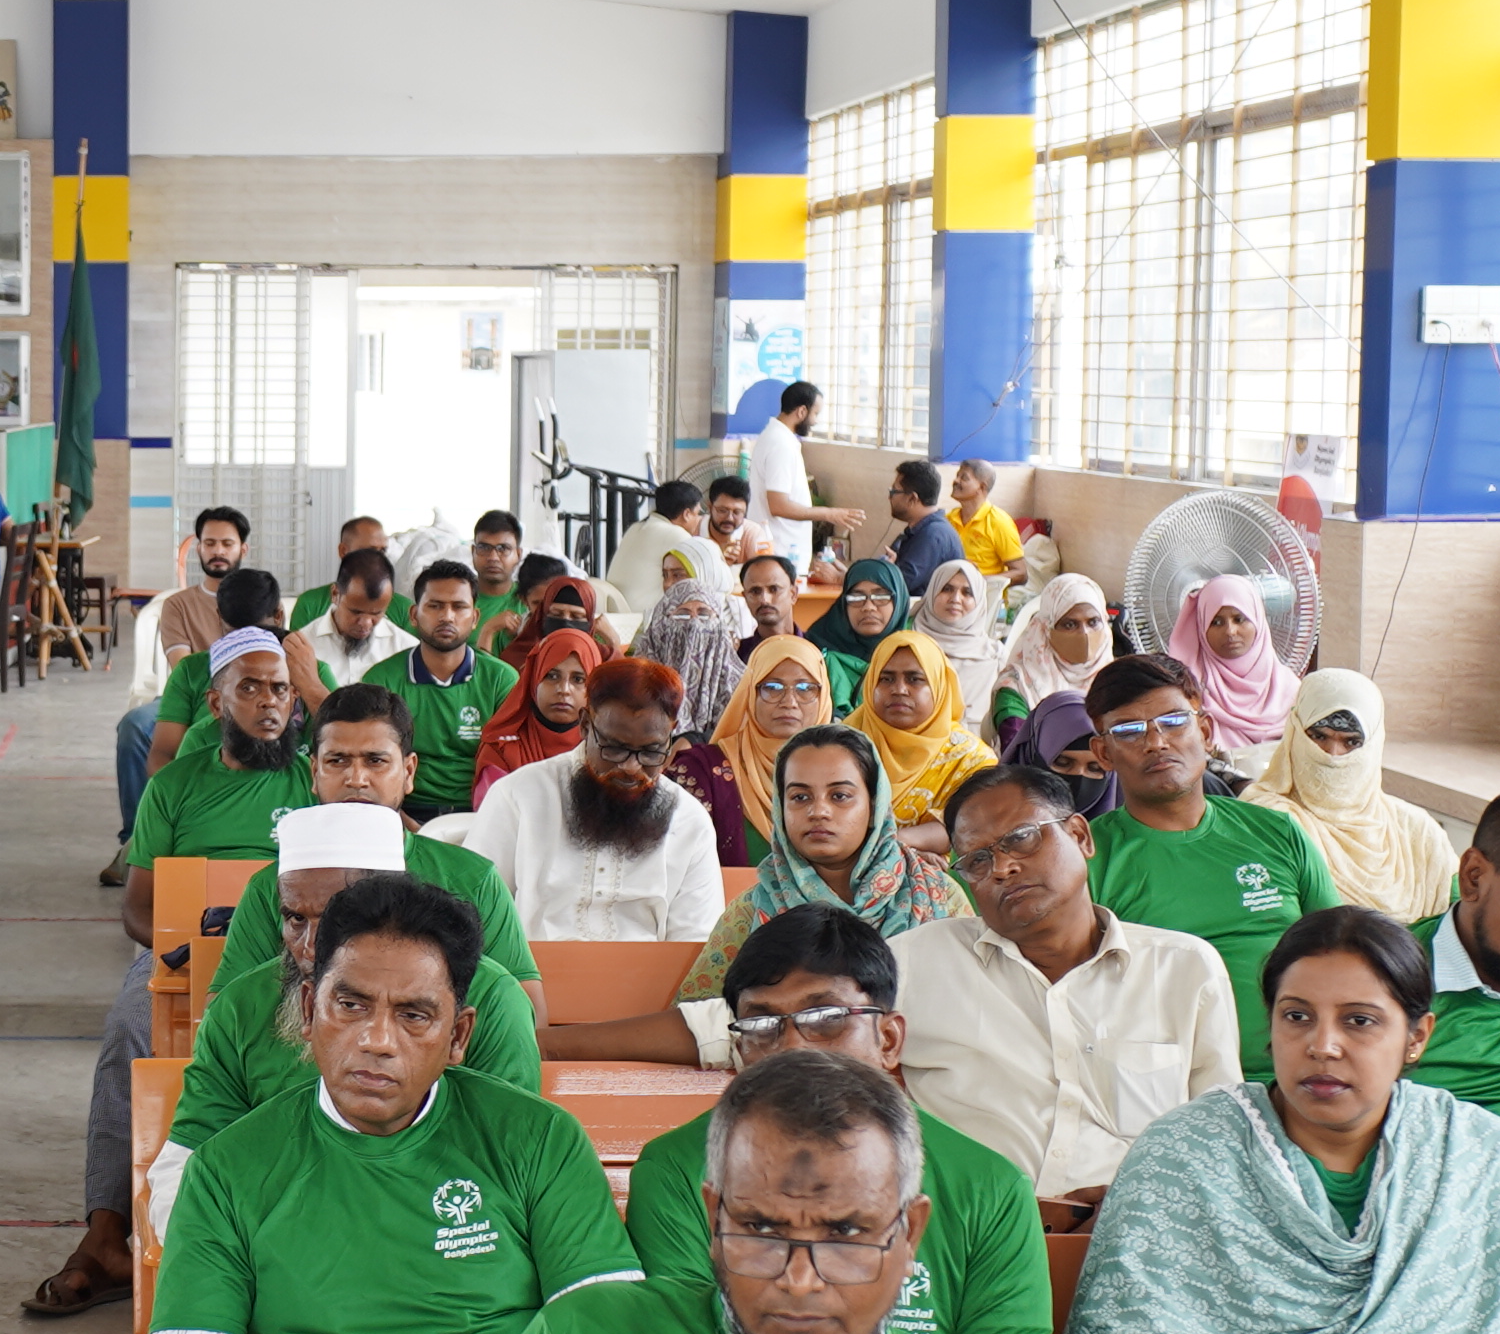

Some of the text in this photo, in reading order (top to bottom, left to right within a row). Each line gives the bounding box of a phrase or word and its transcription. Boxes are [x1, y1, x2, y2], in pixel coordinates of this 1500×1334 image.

[436, 1219, 491, 1239] Special
[434, 1231, 499, 1251] Olympics
[443, 1243, 496, 1259] Bangladesh
